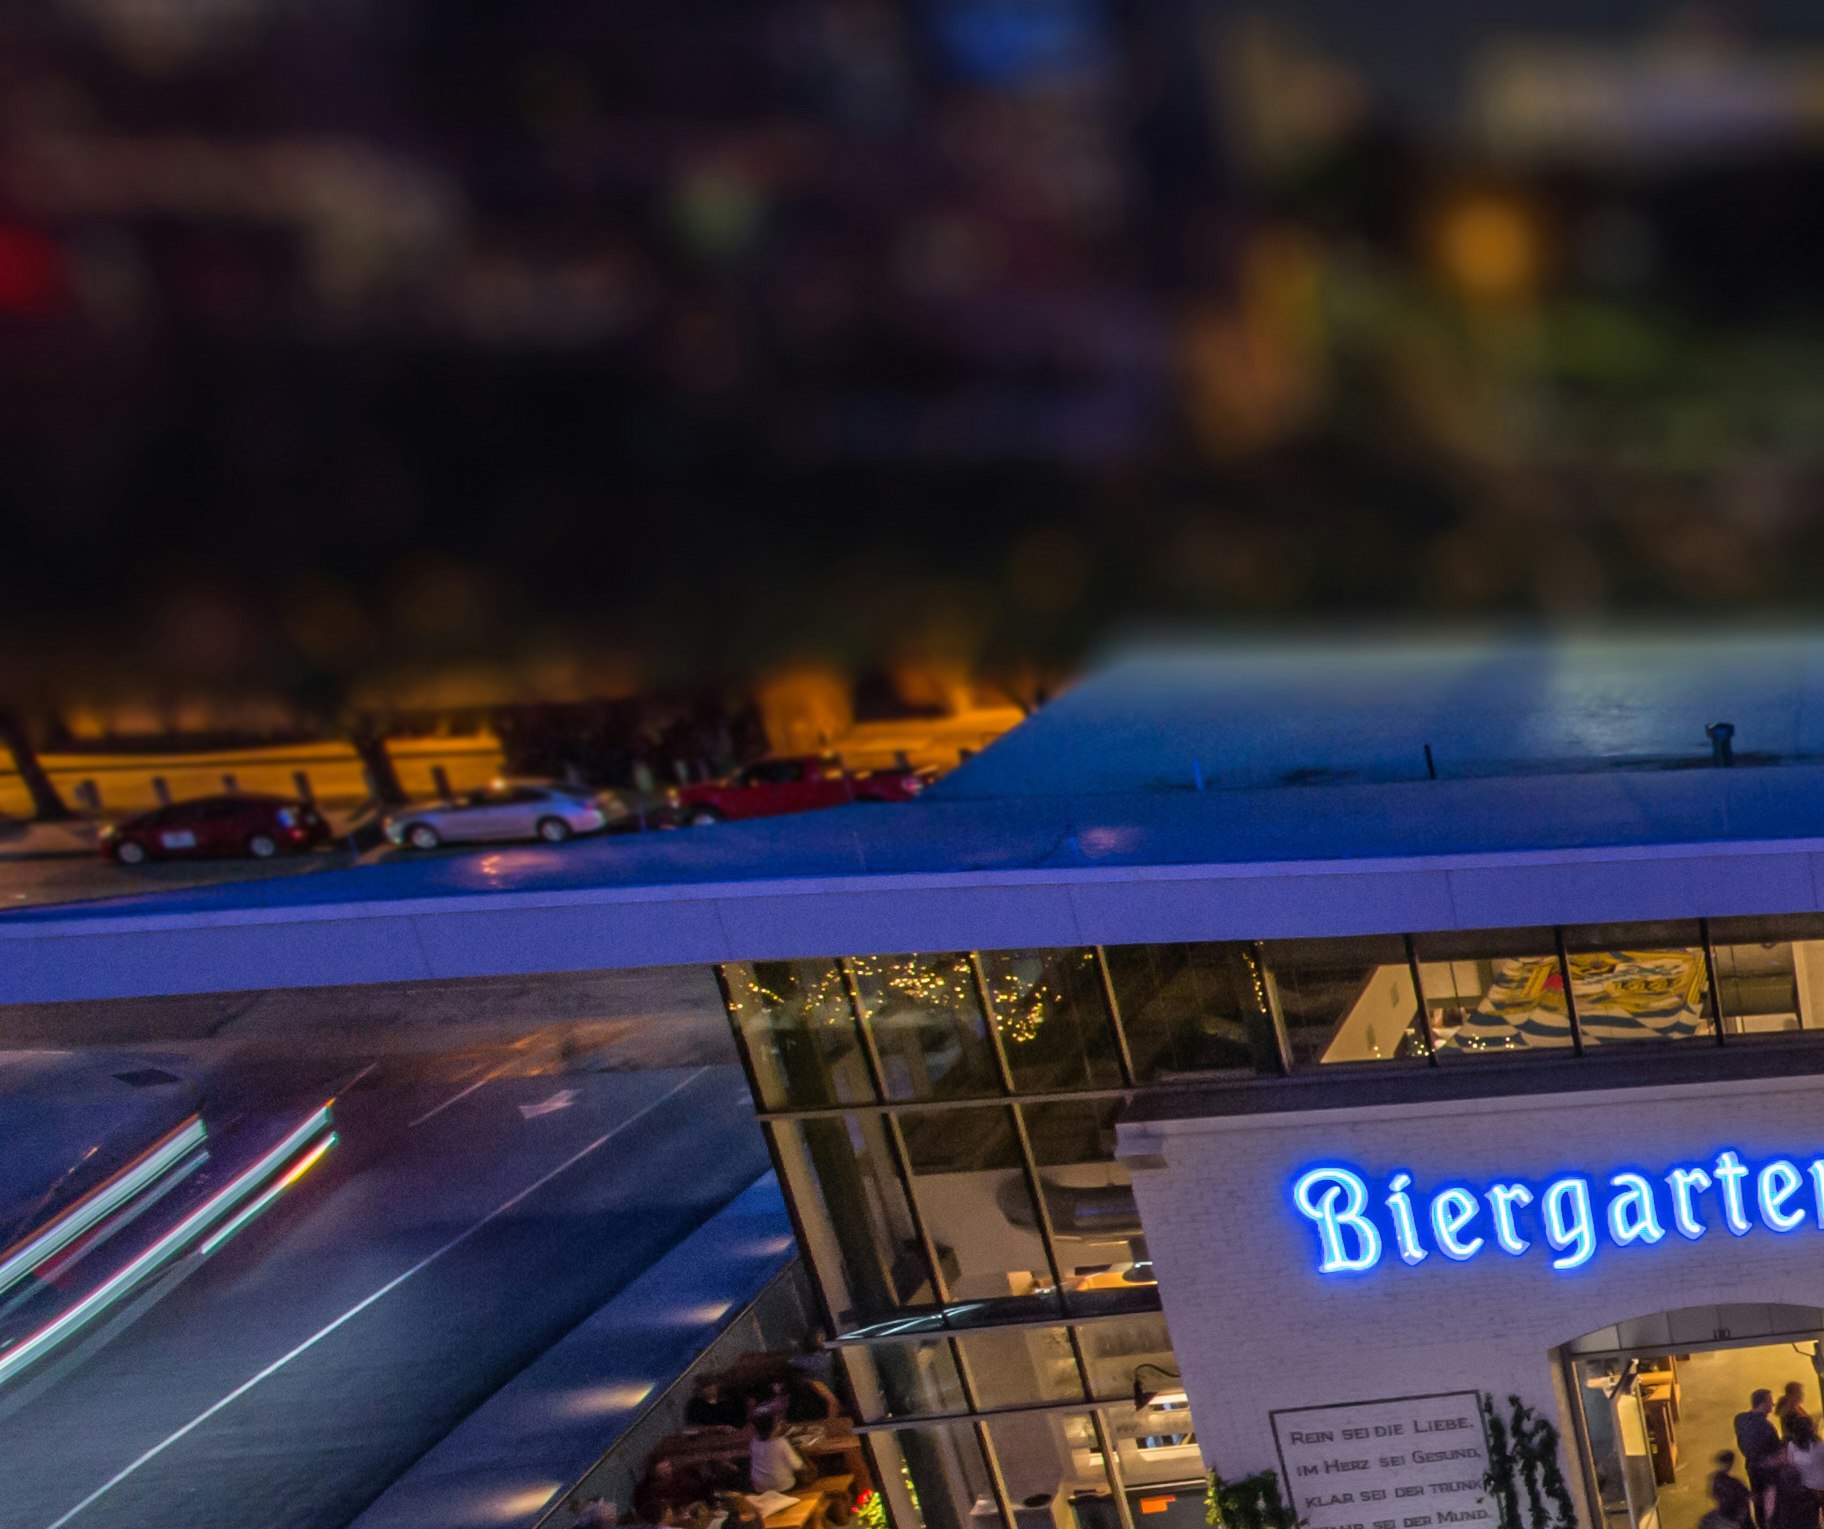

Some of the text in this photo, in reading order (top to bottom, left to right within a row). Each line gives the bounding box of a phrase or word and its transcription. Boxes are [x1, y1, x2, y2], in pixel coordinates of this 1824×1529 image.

[1290, 1430, 1335, 1445] REIN
[1341, 1427, 1370, 1441] SEI
[1374, 1424, 1404, 1437] DIE
[1297, 1464, 1319, 1477] IM
[1323, 1459, 1370, 1474] HERZ
[1379, 1455, 1406, 1468] SEI
[1304, 1494, 1355, 1509] KLAR
[1360, 1489, 1387, 1502] SEI
